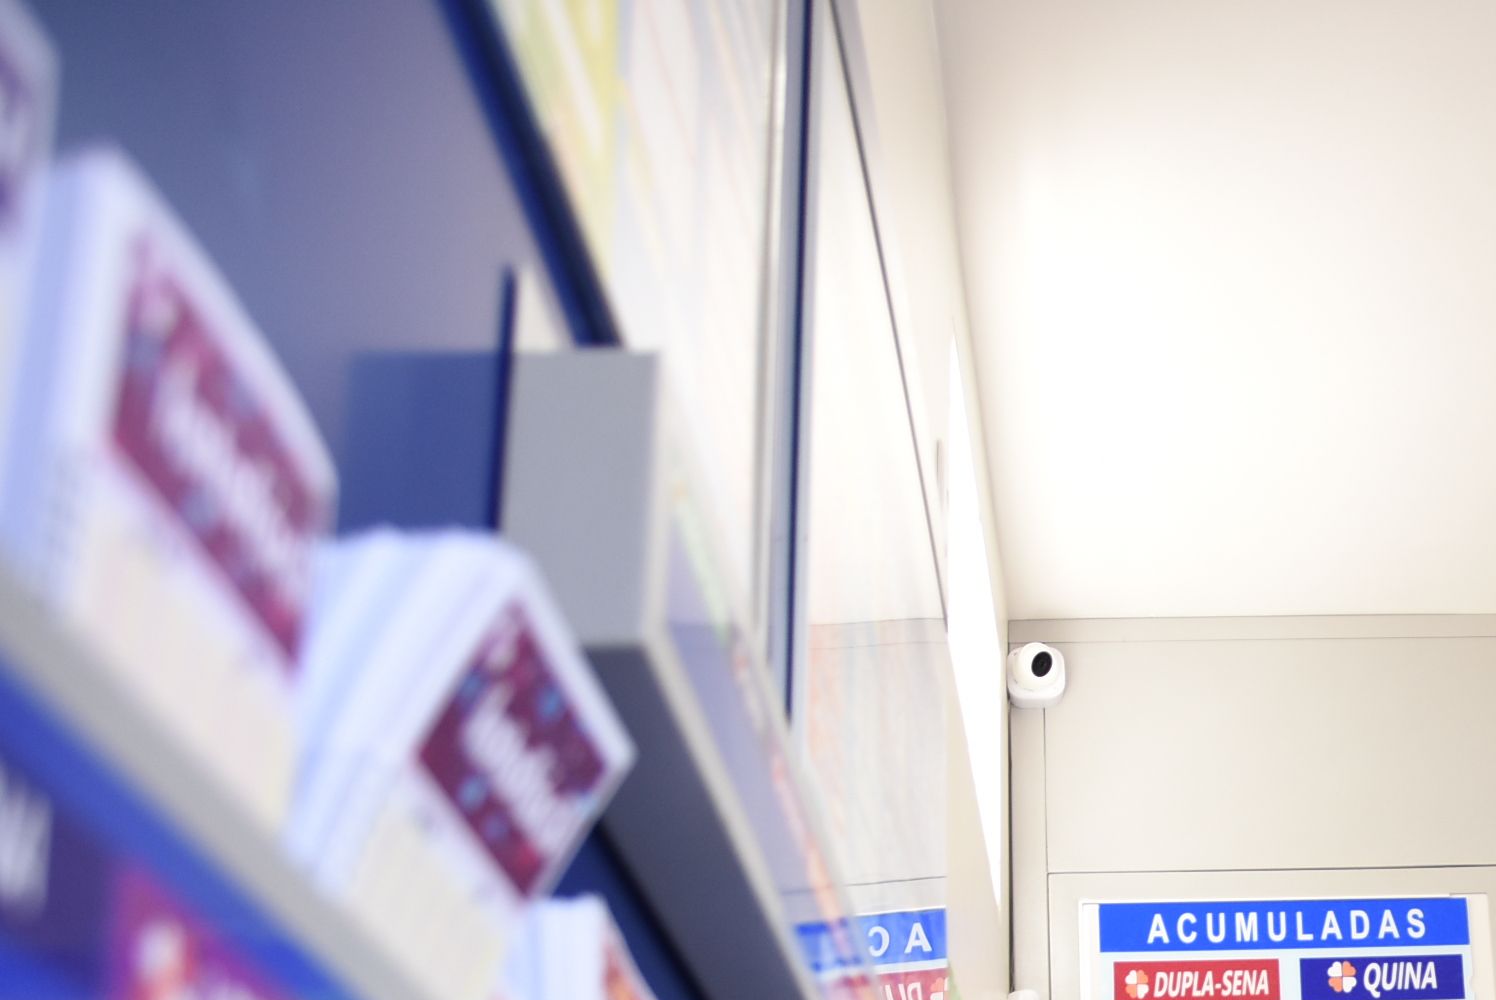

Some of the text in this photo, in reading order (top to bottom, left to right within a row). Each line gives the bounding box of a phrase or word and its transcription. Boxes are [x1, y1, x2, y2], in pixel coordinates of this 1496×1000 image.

[1147, 908, 1428, 945] ACUMULADAS
[1153, 968, 1270, 999] DUPLA-SENA
[1362, 961, 1438, 998] QUINA
